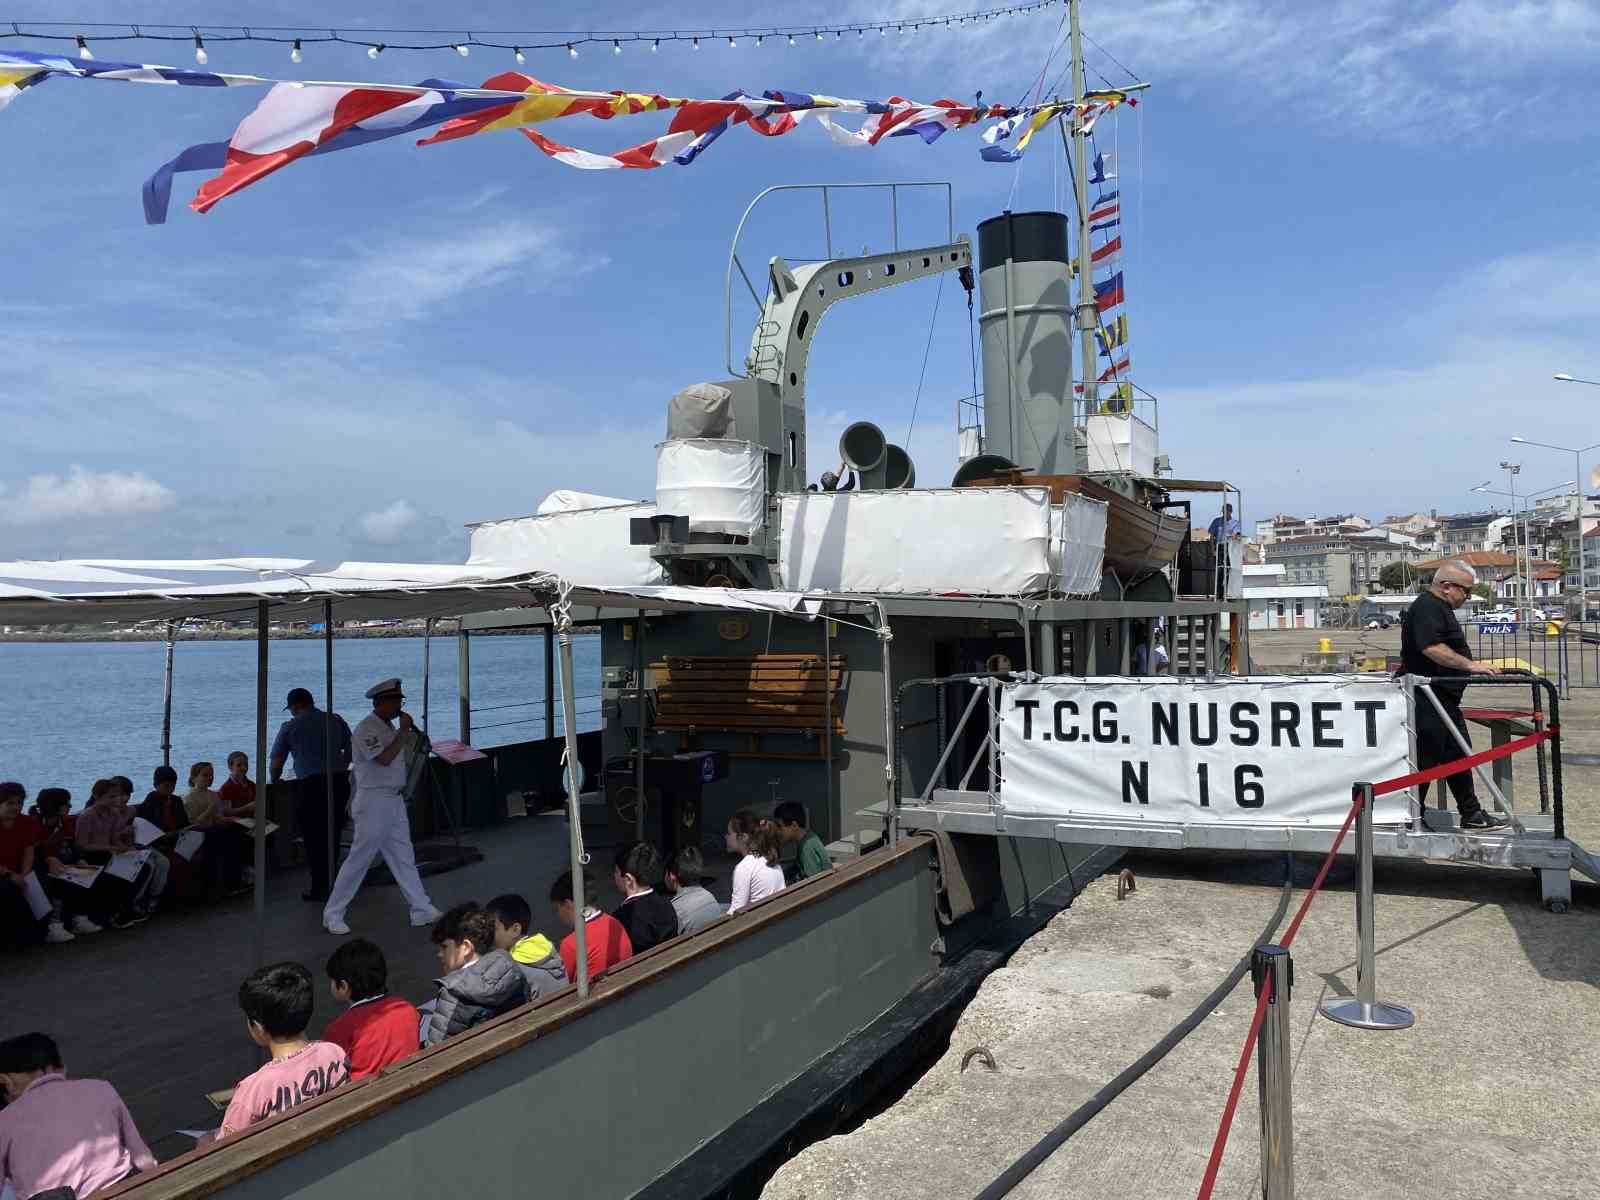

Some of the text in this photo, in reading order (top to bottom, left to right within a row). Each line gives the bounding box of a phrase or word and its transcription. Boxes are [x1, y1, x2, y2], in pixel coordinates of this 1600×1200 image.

[1015, 700, 1386, 748] T.C.G. NUSRET
[1121, 761, 1149, 804] N
